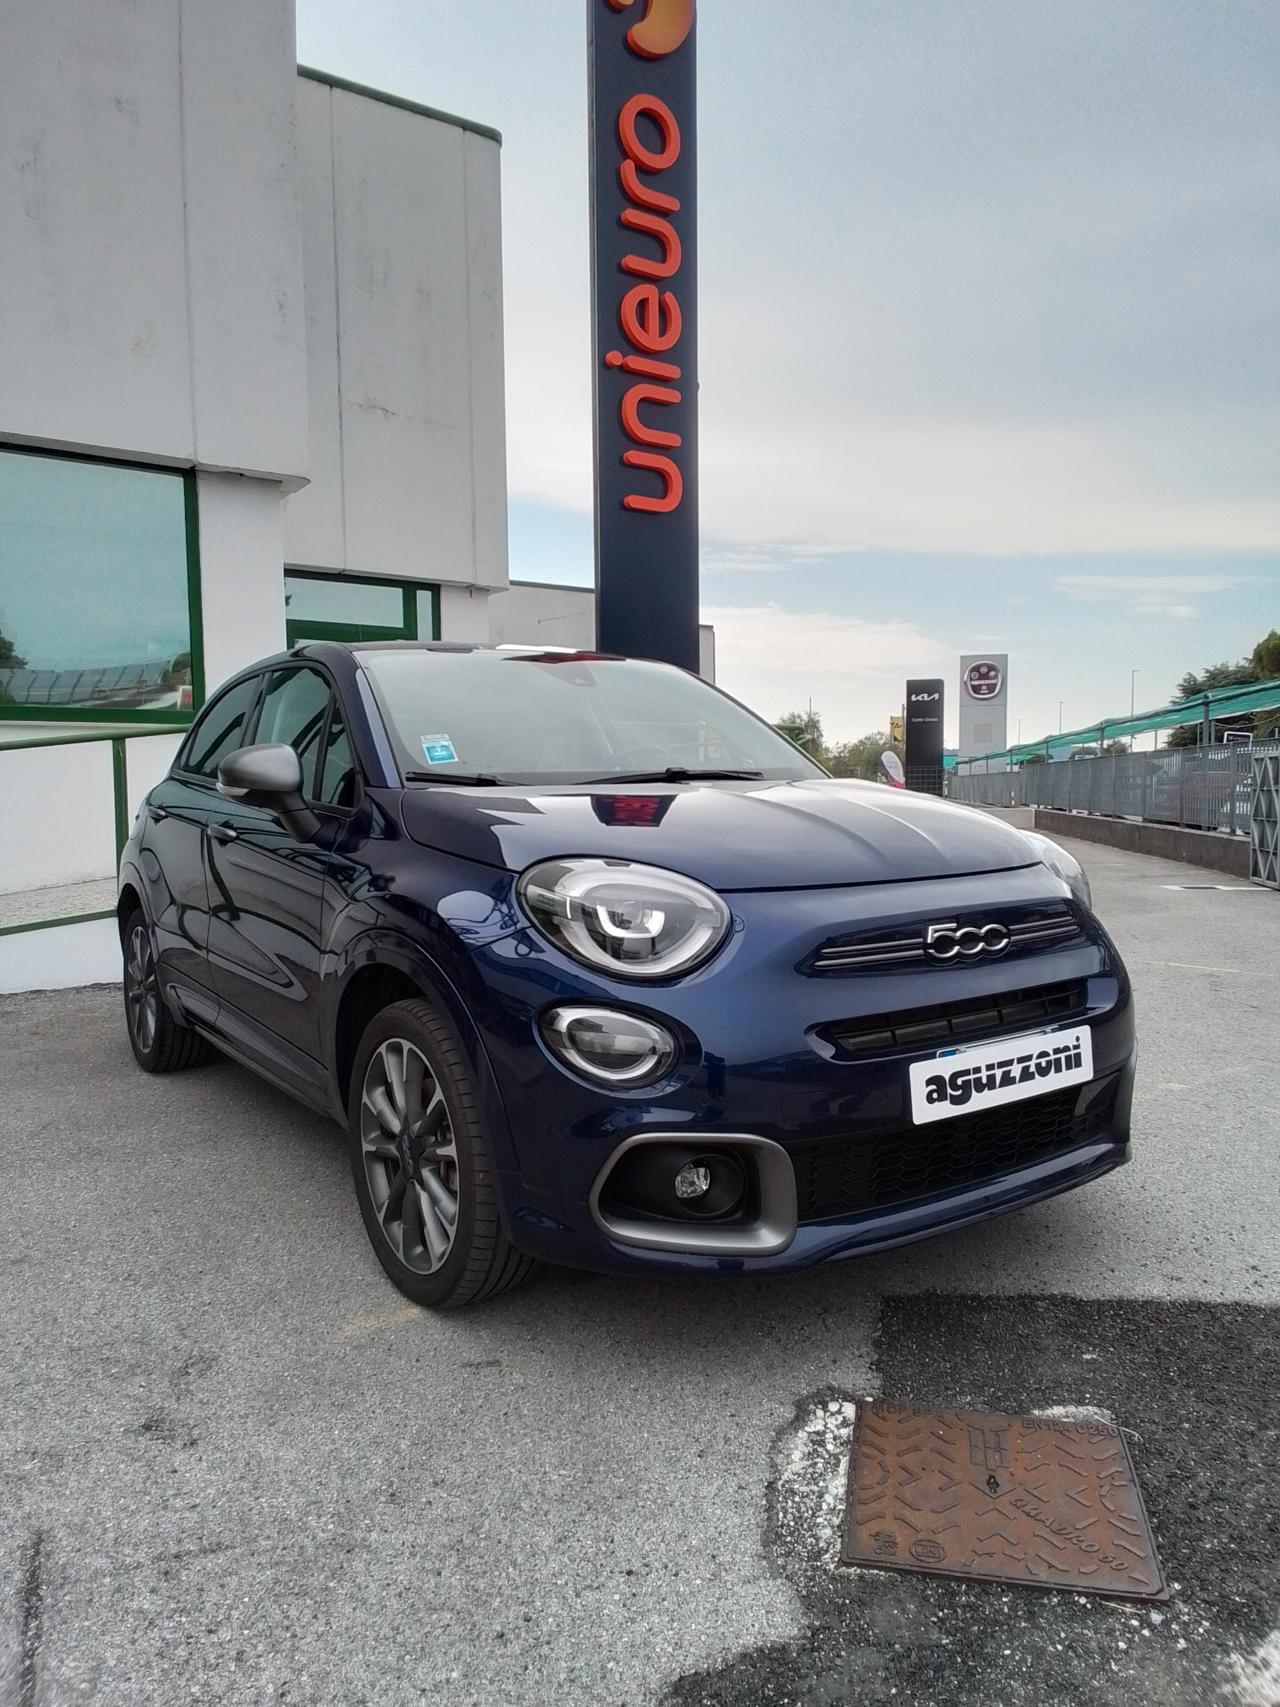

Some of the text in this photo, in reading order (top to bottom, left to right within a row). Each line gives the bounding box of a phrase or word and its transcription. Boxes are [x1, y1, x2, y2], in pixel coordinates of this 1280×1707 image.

[604, 93, 683, 513] unieuro
[927, 922, 1010, 958] 500
[925, 1035, 1083, 1106] aguzzoni
[1023, 1419, 1042, 1430] EN
[1076, 1424, 1119, 1437] C250
